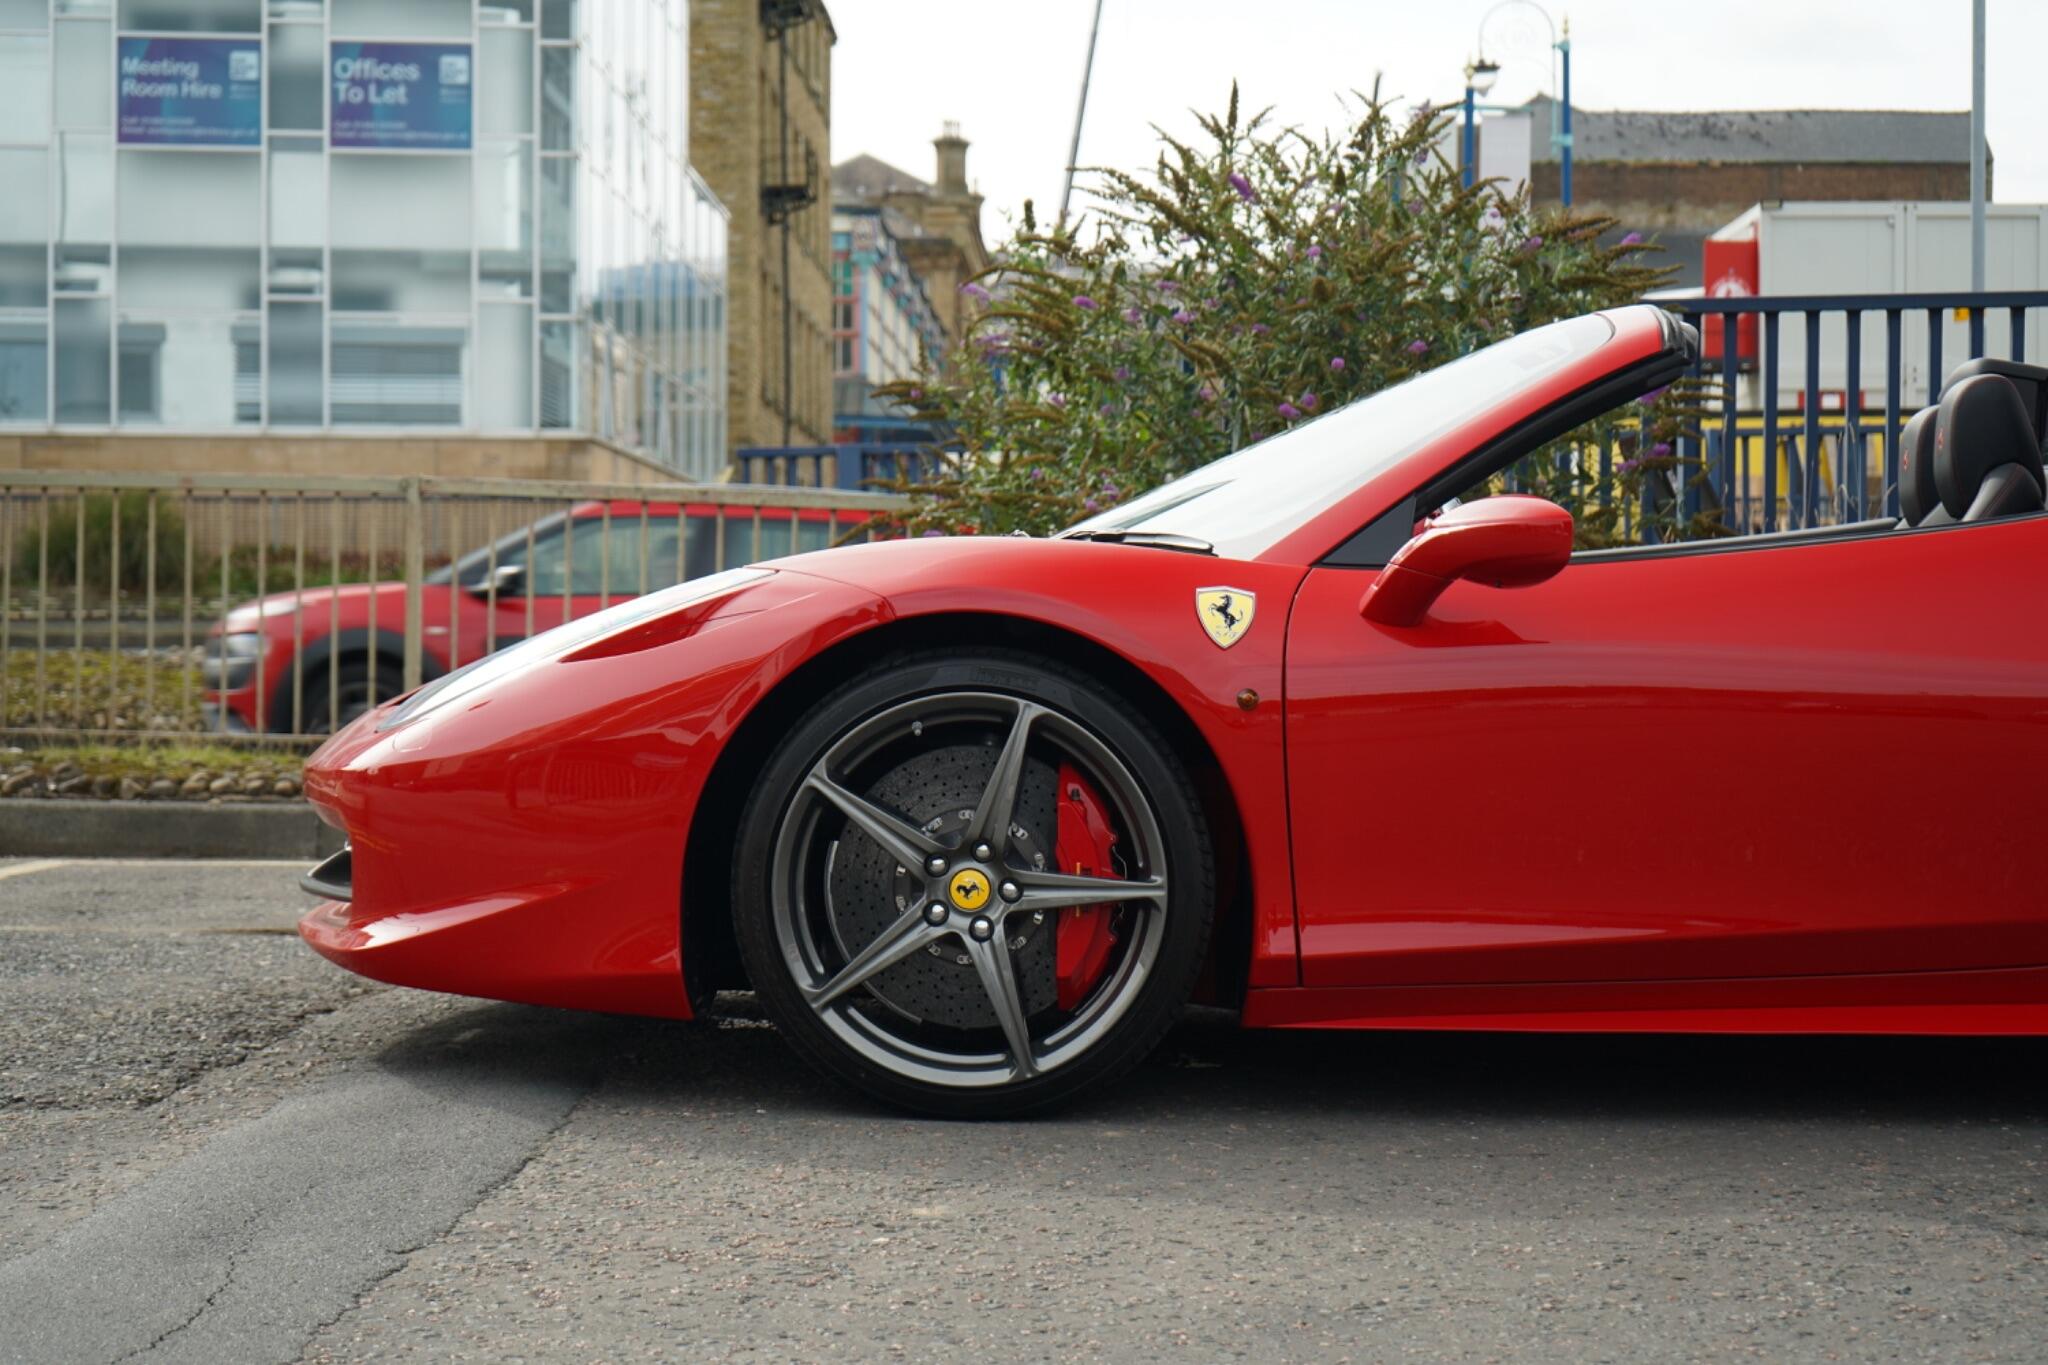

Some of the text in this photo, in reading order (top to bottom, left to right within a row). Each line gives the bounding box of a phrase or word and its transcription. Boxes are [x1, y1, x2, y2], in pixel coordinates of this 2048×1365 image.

[121, 56, 199, 80] Meeting
[333, 57, 422, 81] Offices
[121, 79, 178, 98] Room
[181, 80, 223, 99] Hire
[333, 81, 407, 105] To Let
